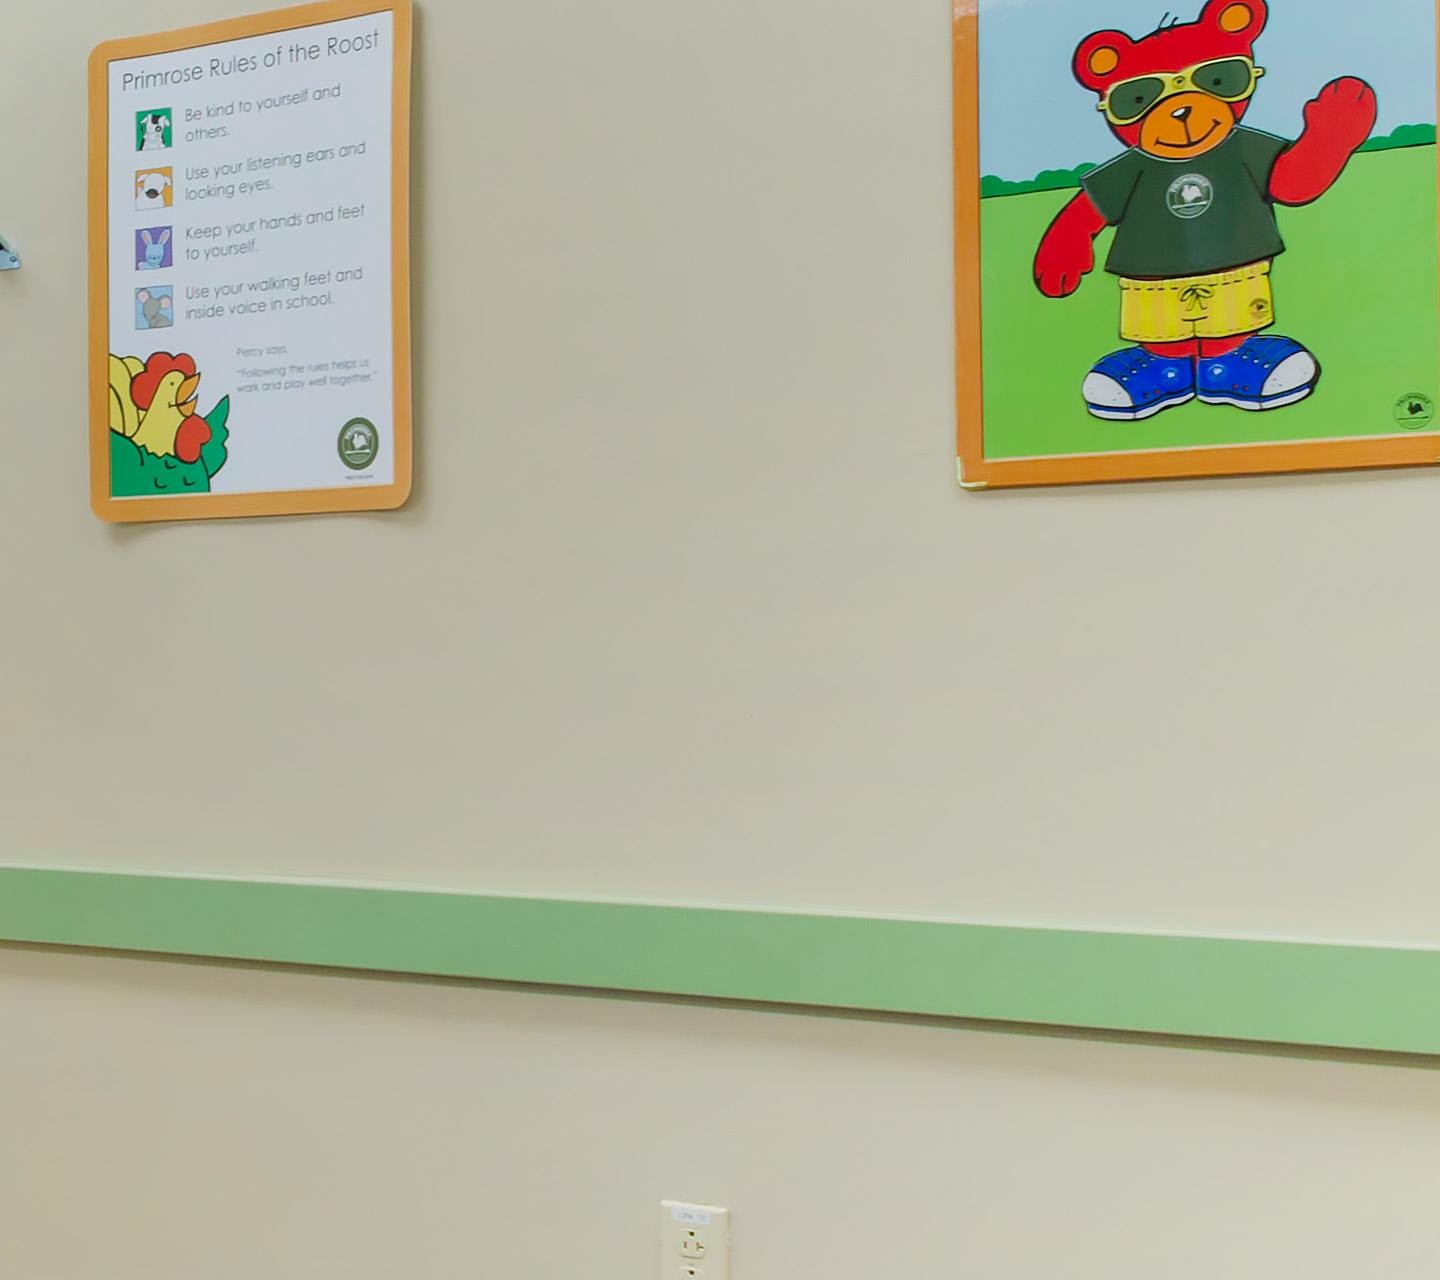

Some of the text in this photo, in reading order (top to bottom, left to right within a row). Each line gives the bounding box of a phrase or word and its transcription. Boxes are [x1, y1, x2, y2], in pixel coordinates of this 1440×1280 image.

[122, 29, 379, 92] Primrose Rules of the Roost
[185, 83, 341, 122] Be kind to yourself and
[185, 124, 230, 142] others.
[185, 141, 366, 180] Use your listening ears and
[185, 178, 273, 200] looking eyes.
[185, 204, 365, 240] Keep your hands and feet
[185, 239, 259, 261] to yourself.
[185, 267, 363, 299] Use your walking feet and
[185, 290, 335, 320] inside voice in school.
[289, 363, 305, 373] the
[331, 359, 357, 371] helps
[262, 381, 281, 392] and
[284, 379, 305, 391] play
